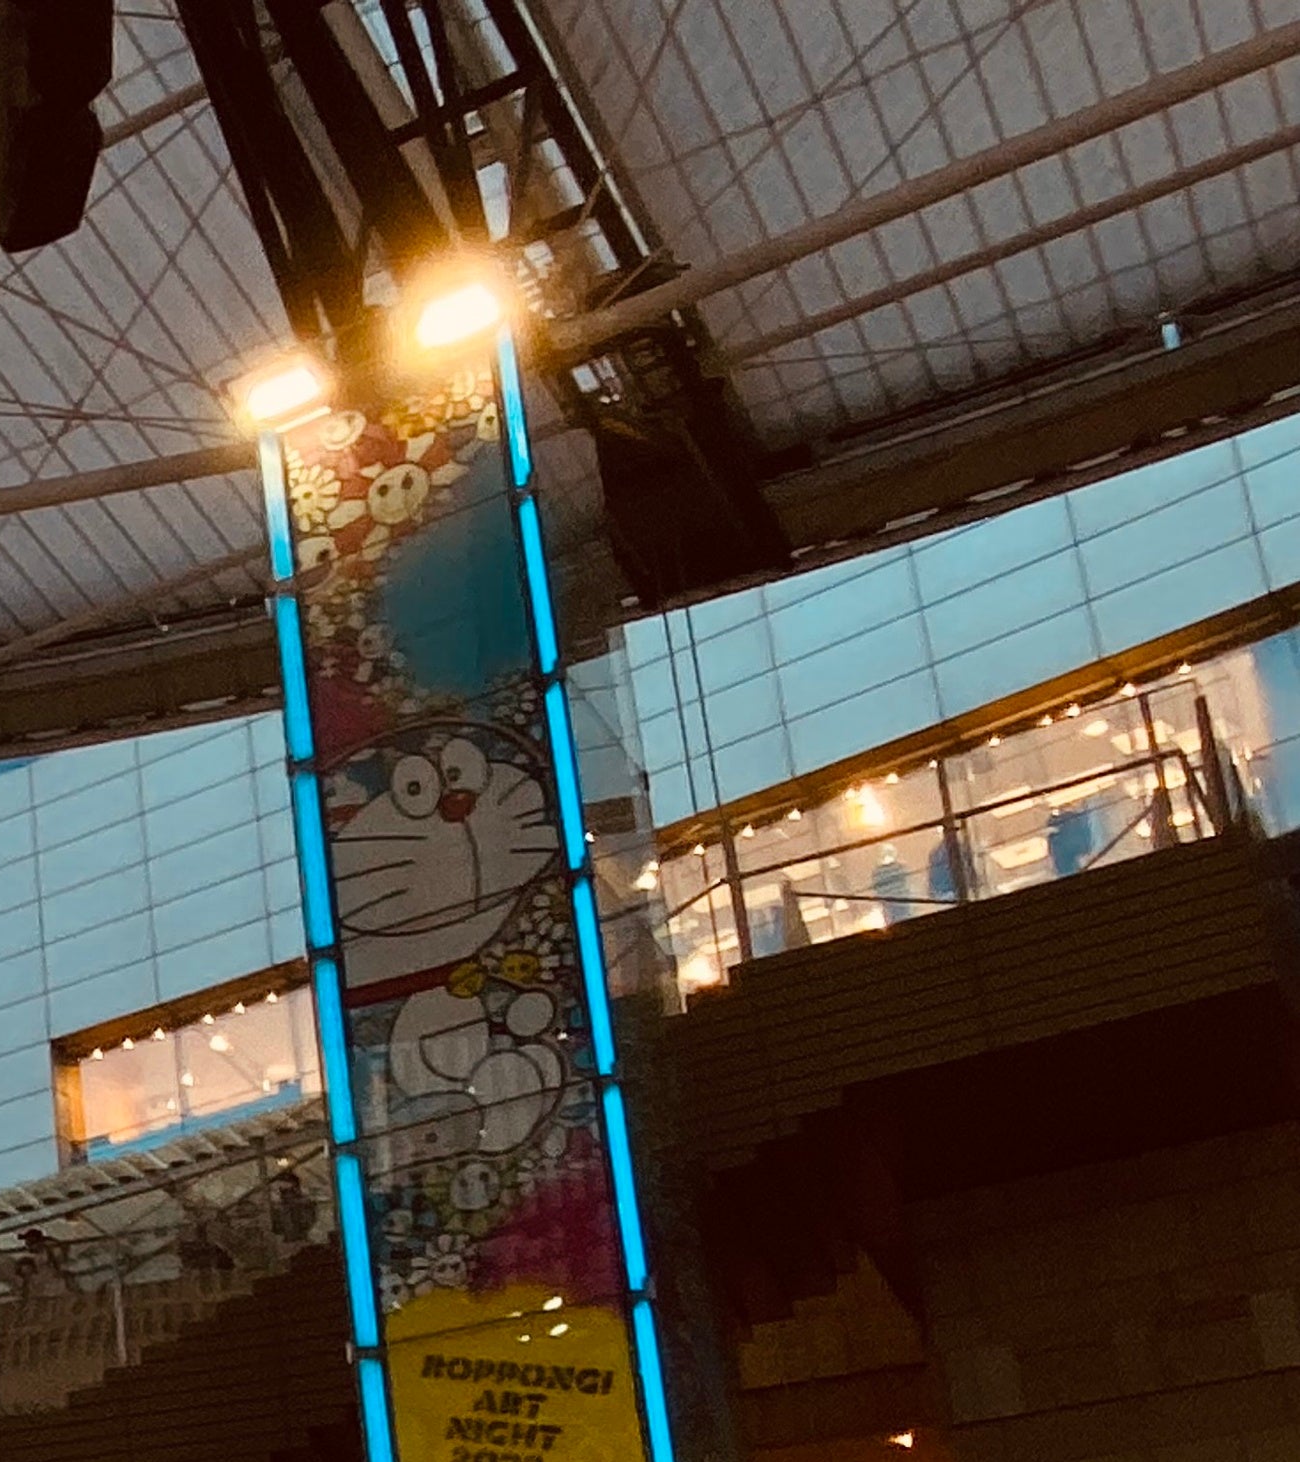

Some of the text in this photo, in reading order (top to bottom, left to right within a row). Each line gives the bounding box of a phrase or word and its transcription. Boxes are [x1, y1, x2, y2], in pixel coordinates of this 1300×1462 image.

[422, 1354, 615, 1394] ROPPONGI
[473, 1389, 548, 1419] ART
[445, 1417, 563, 1451] NIGHT
